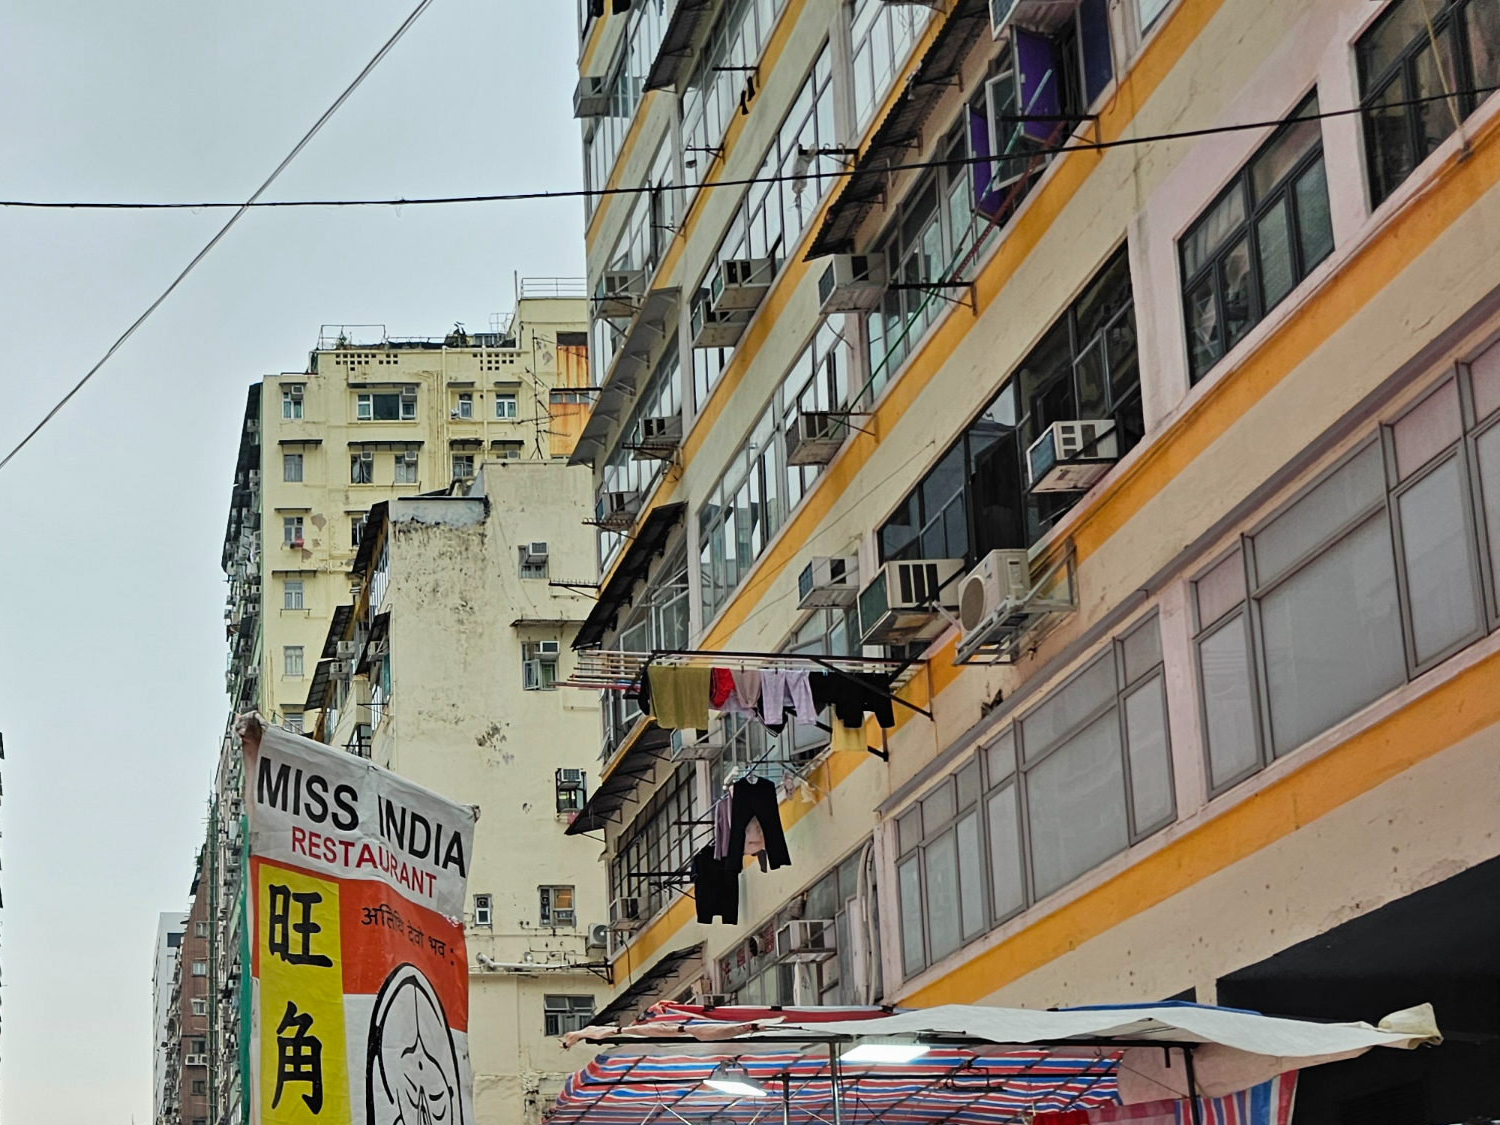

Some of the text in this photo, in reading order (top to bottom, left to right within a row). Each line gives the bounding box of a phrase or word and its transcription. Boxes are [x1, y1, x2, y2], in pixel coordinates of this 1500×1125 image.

[257, 757, 467, 878] MISS INDIA
[291, 826, 437, 899] RESTAURANT
